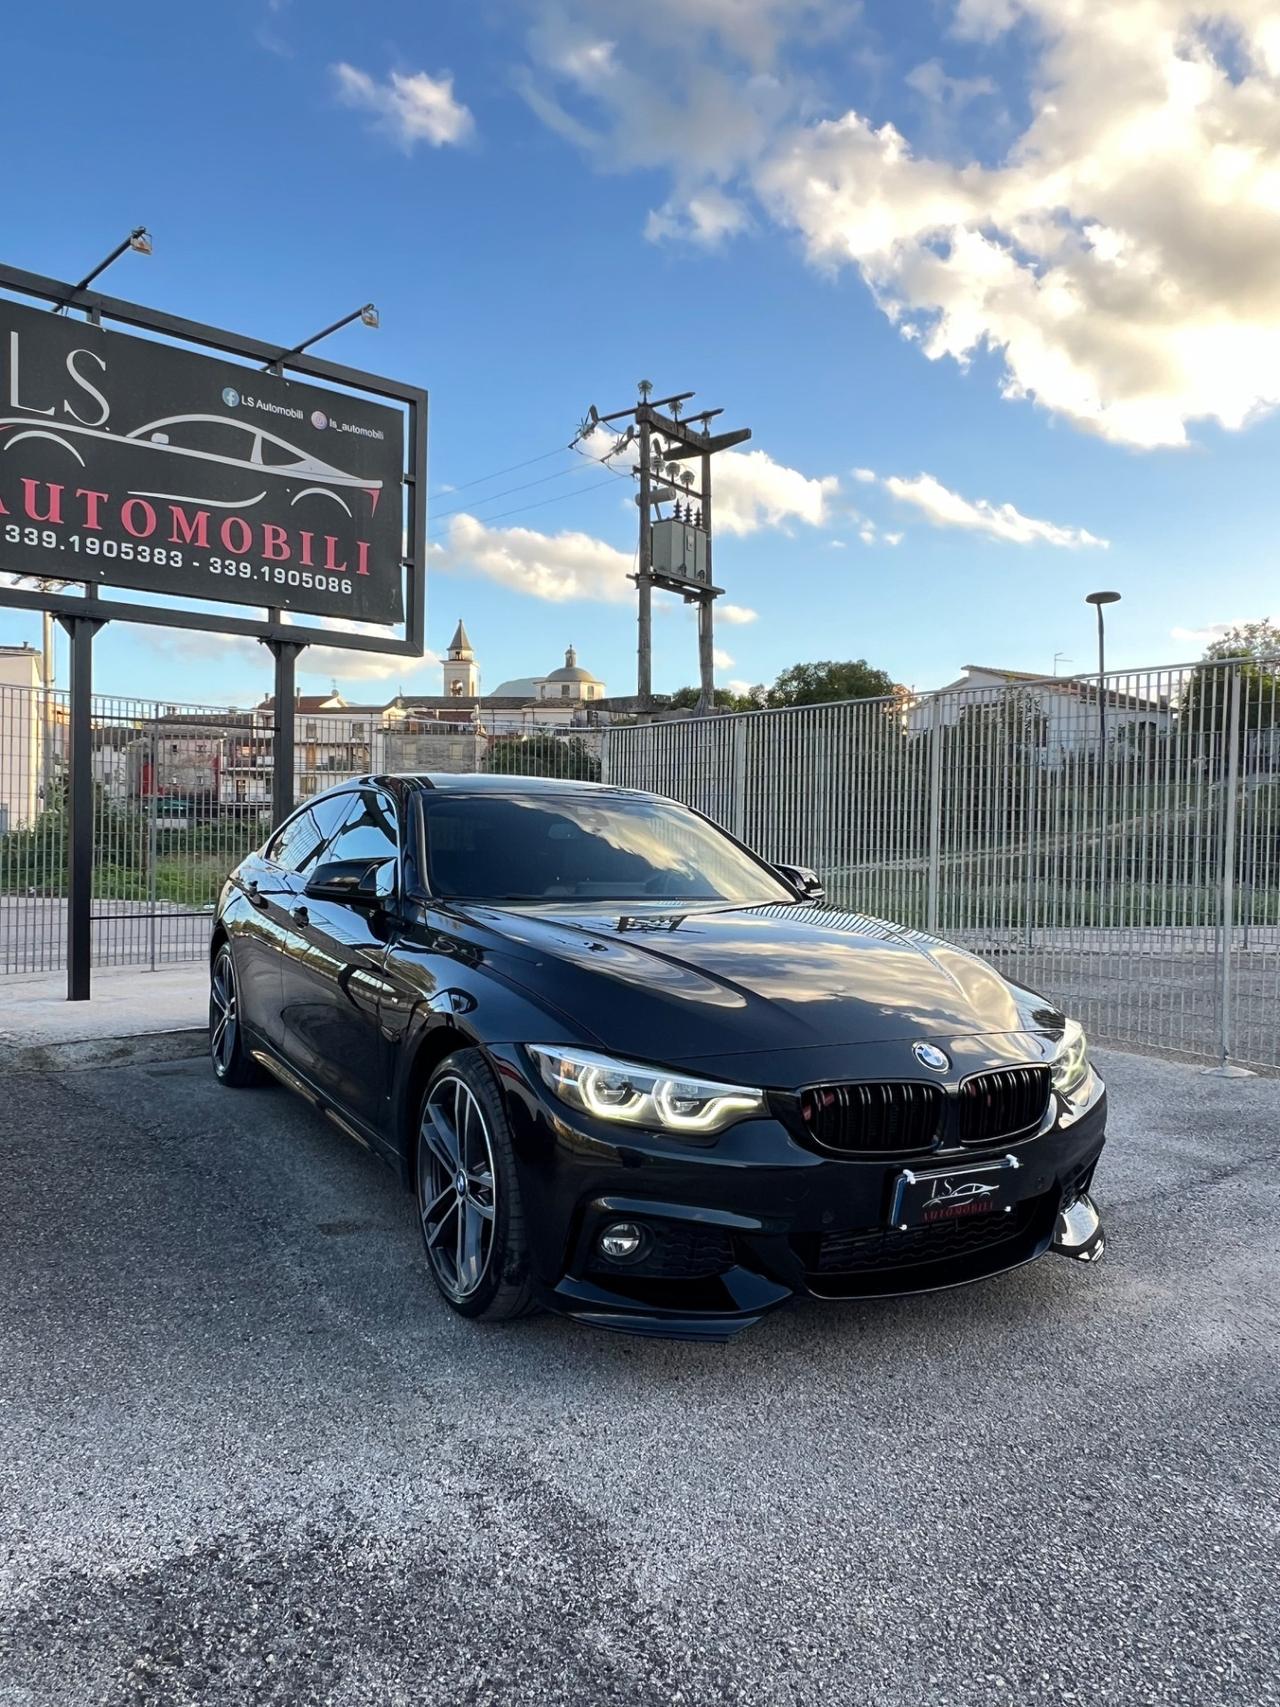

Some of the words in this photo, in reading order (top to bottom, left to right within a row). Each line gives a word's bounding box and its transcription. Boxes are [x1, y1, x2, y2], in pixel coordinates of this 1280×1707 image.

[9, 330, 111, 426] LS
[241, 394, 255, 408] LS
[256, 399, 304, 420] Automobili
[329, 418, 385, 440] ls_automobili
[5, 524, 183, 568] 339.1905383
[209, 556, 353, 595] 339.1905086
